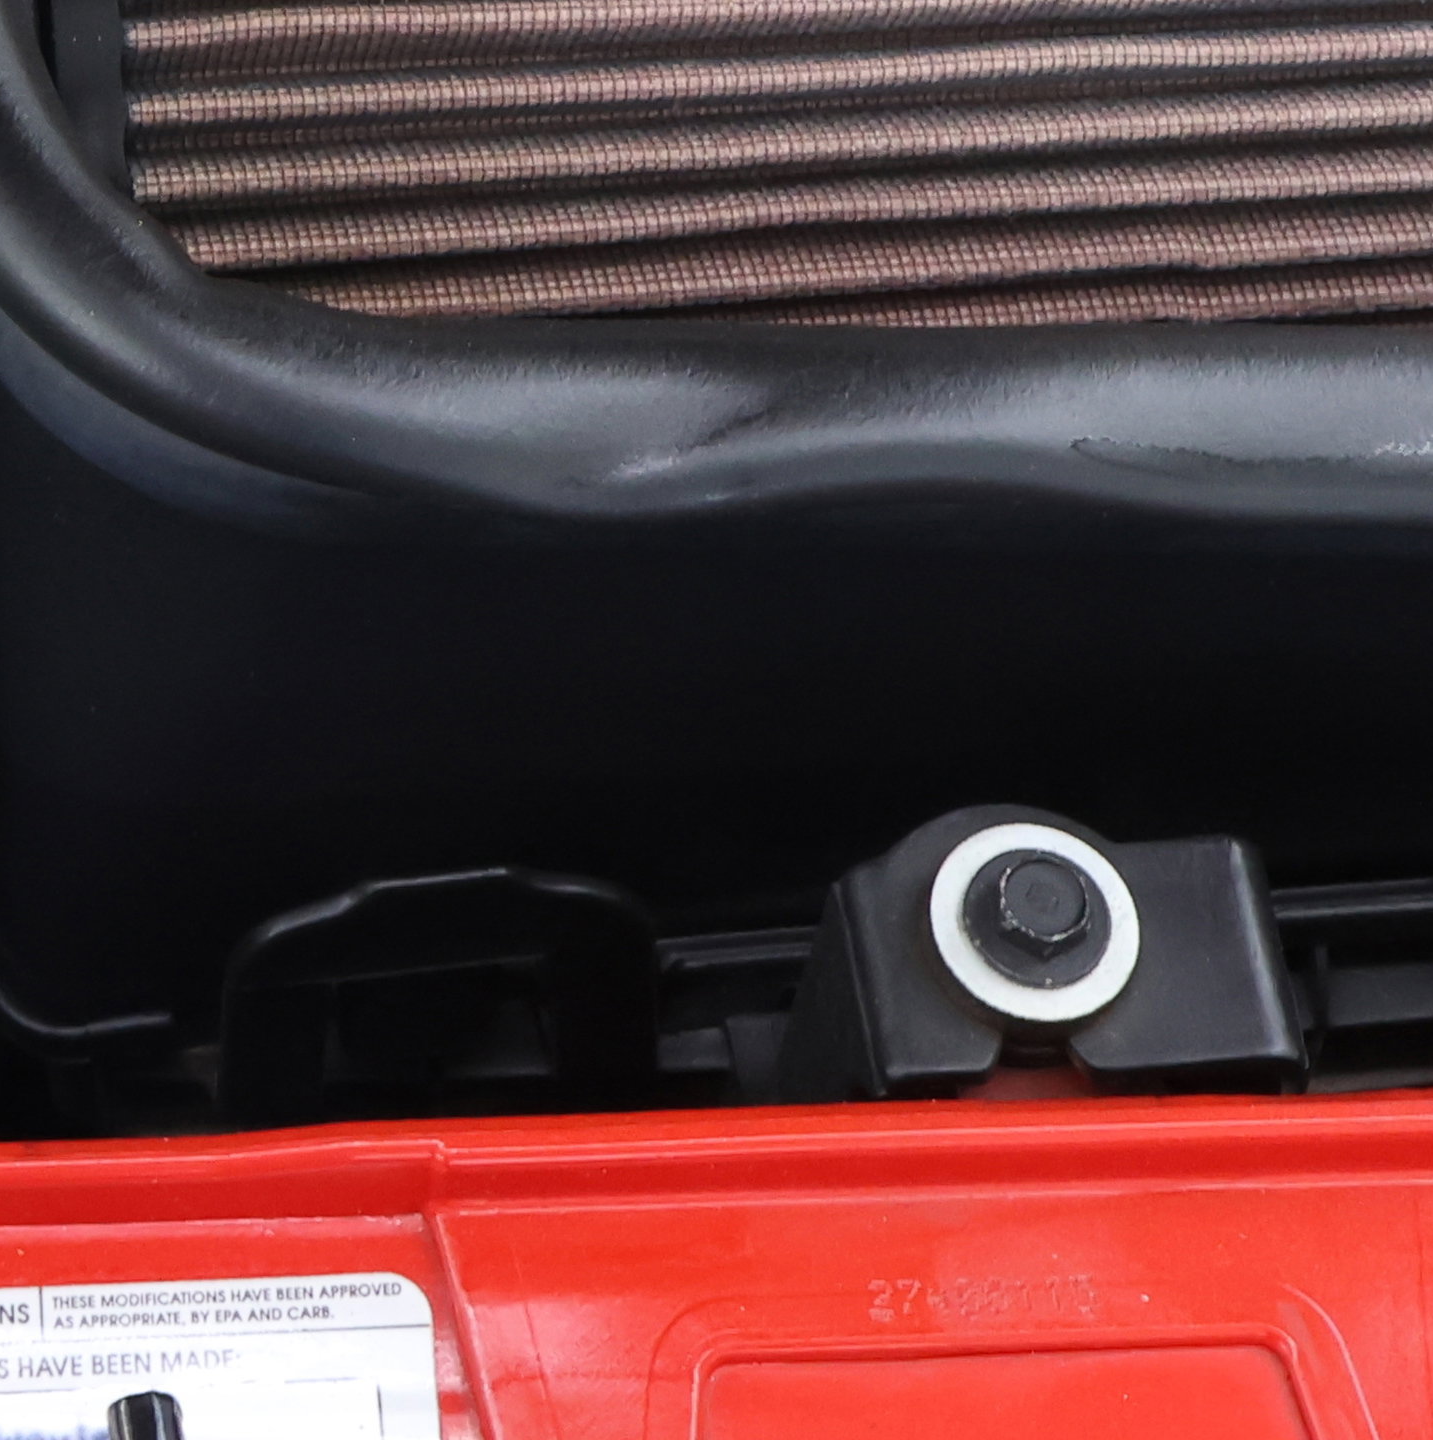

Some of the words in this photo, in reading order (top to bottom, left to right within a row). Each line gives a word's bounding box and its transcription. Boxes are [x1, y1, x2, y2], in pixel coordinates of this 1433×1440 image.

[52, 1294, 96, 1309] THESE
[100, 1289, 227, 1308] MODIFICATIONS
[231, 1287, 274, 1303] HAVE
[276, 1285, 314, 1301] BEEN
[319, 1282, 403, 1299] APPROVED
[53, 1315, 75, 1330] AS
[78, 1312, 187, 1329] APPROPRIATE,
[191, 1311, 211, 1324] BY
[215, 1309, 242, 1323] EPA
[246, 1307, 283, 1322] AND
[287, 1305, 334, 1321] CARB.
[17, 1354, 83, 1380] HAVE
[91, 1351, 152, 1377] BEEN
